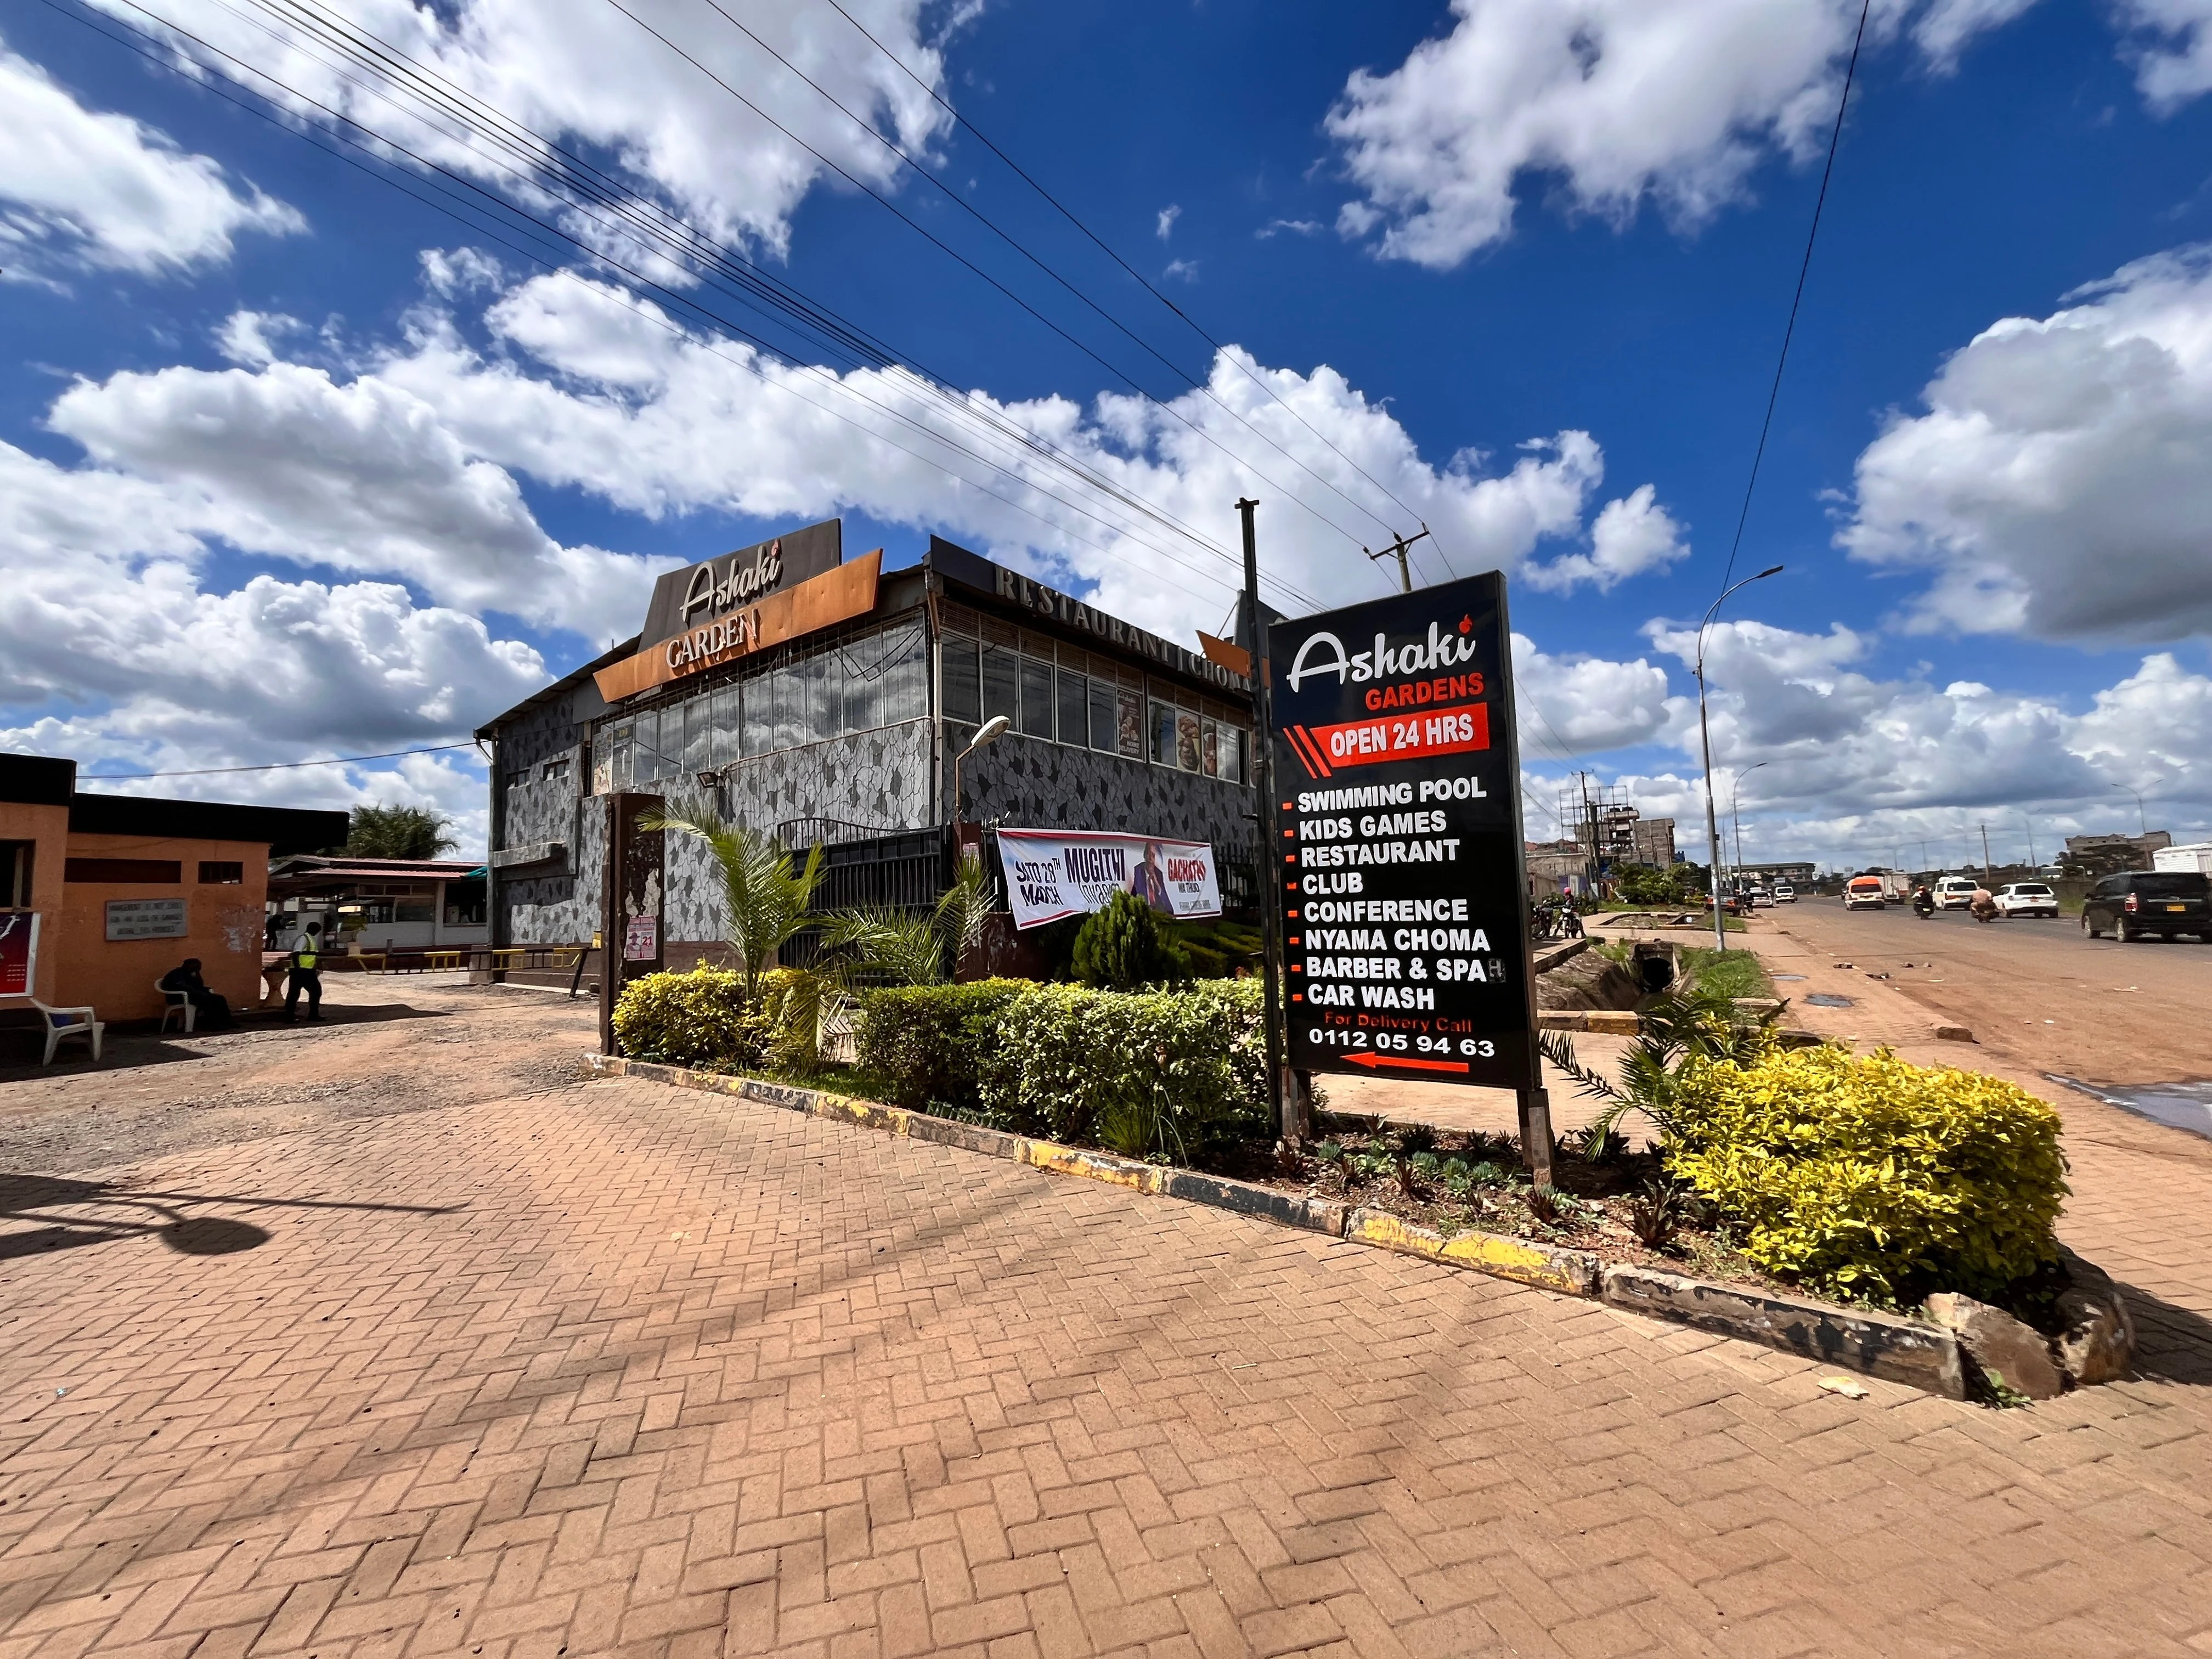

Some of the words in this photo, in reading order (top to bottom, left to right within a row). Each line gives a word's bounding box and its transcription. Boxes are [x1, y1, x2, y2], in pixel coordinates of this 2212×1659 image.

[679, 538, 782, 622] Ashaki
[995, 565, 1170, 663] RESTAURANT
[665, 608, 759, 669] GARDEN
[1286, 613, 1476, 693] Ashaki
[1365, 672, 1485, 711] GARDENS
[1330, 724, 1387, 757] OPEN
[1392, 720, 1420, 749] 24
[1425, 713, 1474, 746] HRS
[1297, 782, 1413, 812] SWIMMING
[1419, 776, 1487, 803] POOL
[1300, 817, 1353, 840] KIDS
[1359, 810, 1447, 837] GAMES
[1064, 848, 1126, 883] MUGITHI
[1301, 838, 1460, 867] RESTAURANT
[1302, 872, 1363, 895] CLUB
[1304, 899, 1469, 922] CONFERENCE
[642, 935, 653, 945] 21
[1305, 929, 1387, 951] NYAMA
[1393, 928, 1491, 951] CHOMA
[1306, 956, 1402, 979] BARBER
[1409, 957, 1428, 979] &
[1308, 983, 1356, 1006] CAR
[1361, 986, 1435, 1010] WASH
[1325, 1011, 1352, 1025] For
[1358, 1013, 1430, 1033] Delivery
[1436, 1018, 1472, 1032] Call
[1309, 1028, 1368, 1047] 0112
[1375, 1032, 1408, 1050] 05
[1416, 1035, 1451, 1054] 94
[1460, 1039, 1495, 1057] 63
